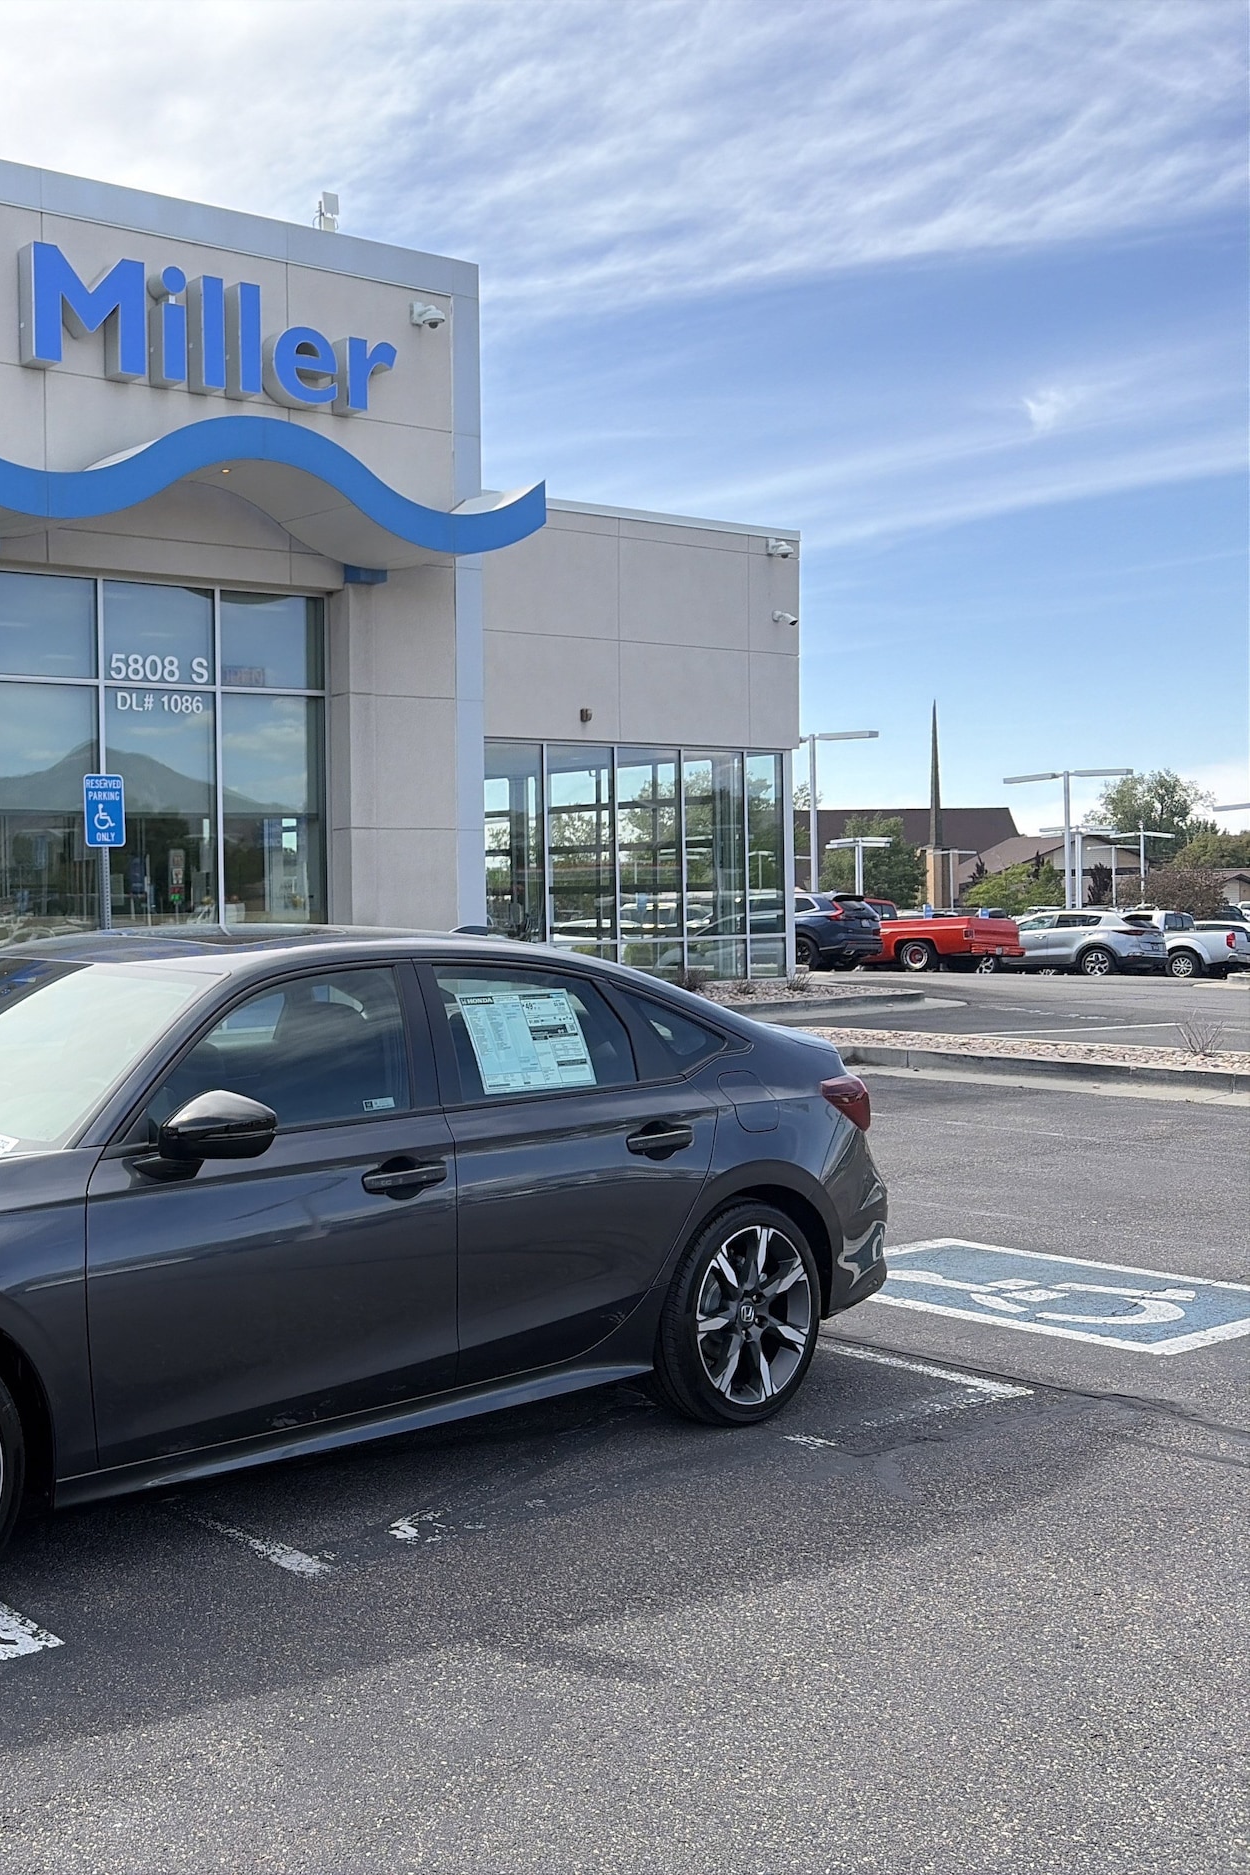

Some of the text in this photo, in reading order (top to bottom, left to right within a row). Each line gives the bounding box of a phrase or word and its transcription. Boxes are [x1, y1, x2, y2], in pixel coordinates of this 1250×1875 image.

[18, 240, 398, 417] Miller
[109, 653, 180, 682] 5808
[191, 657, 209, 684] S
[116, 691, 203, 714] DL# 1086
[85, 778, 121, 789] RESERVED
[88, 791, 120, 801] PARKING
[96, 832, 116, 842] ONLY
[466, 997, 493, 1005] HONDA
